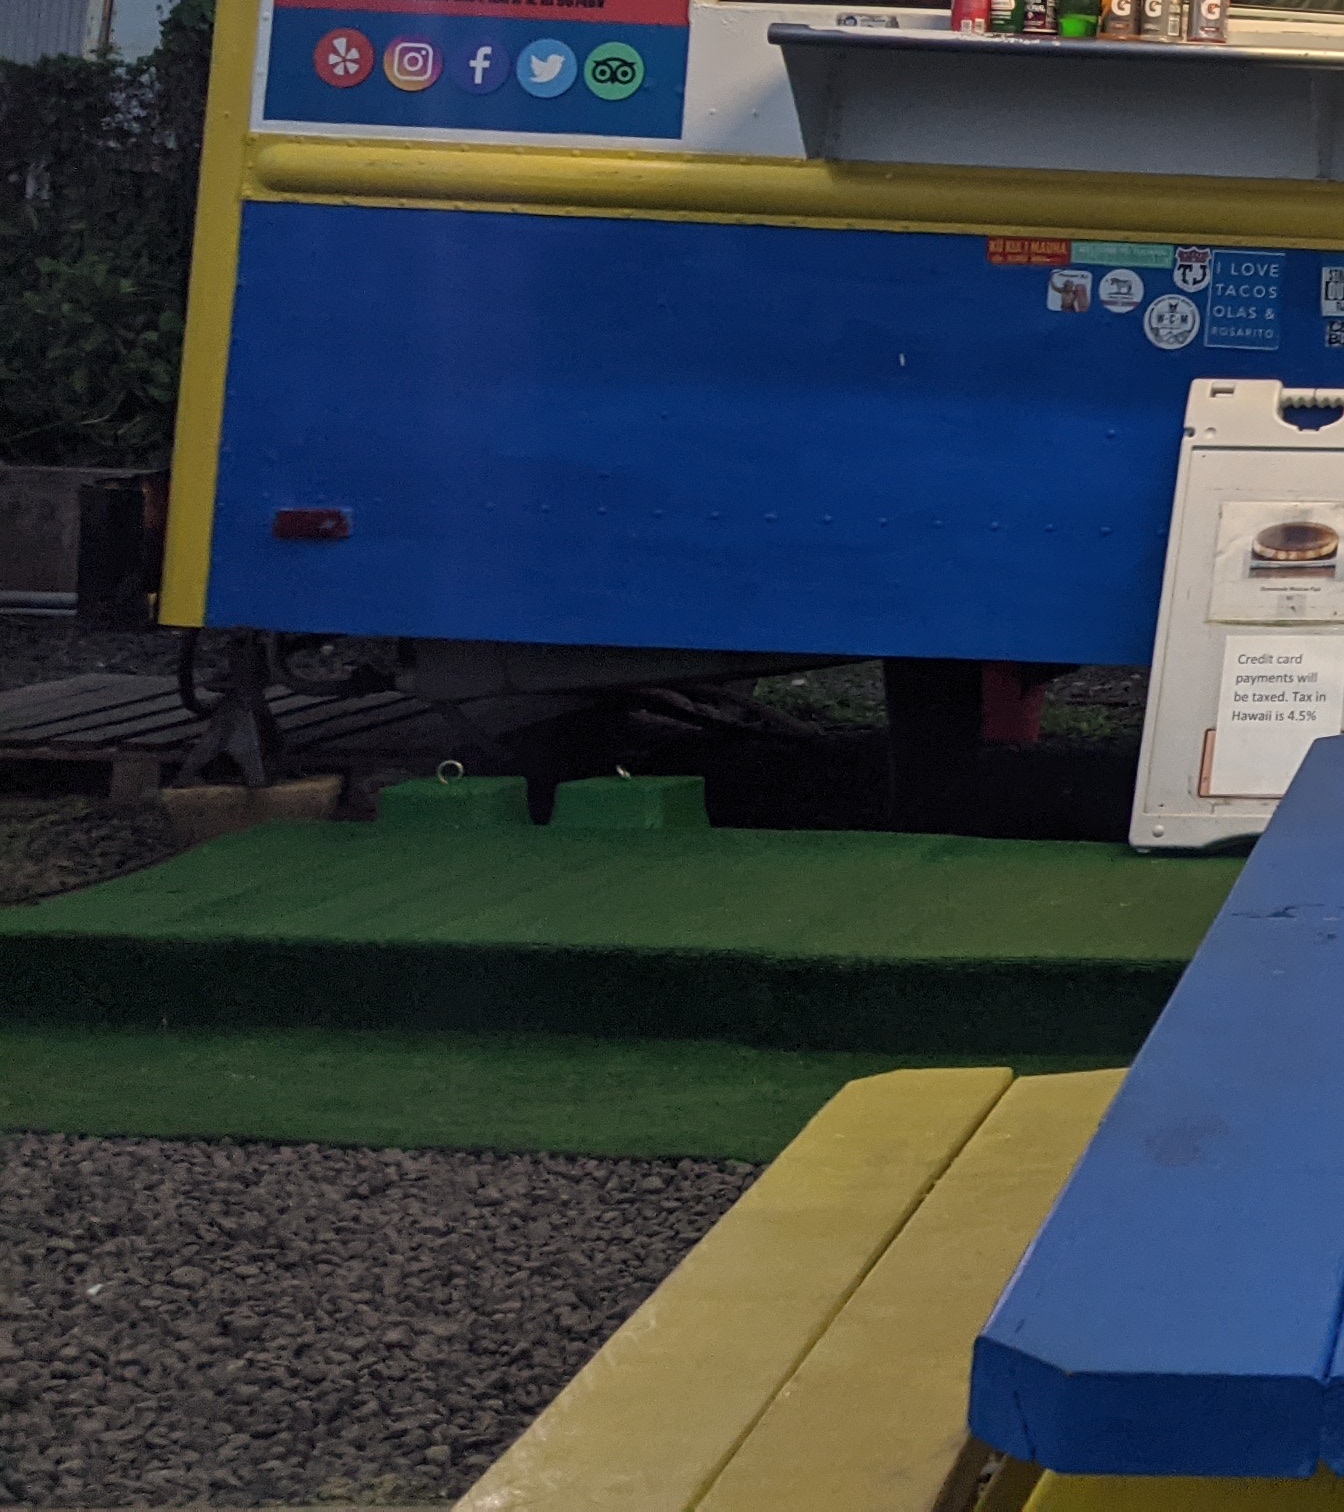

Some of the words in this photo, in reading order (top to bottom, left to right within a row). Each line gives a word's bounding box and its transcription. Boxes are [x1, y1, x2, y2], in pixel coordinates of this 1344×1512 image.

[1231, 262, 1279, 278] LOVE
[1215, 283, 1278, 299] TACOS
[1214, 305, 1258, 320] OLAS
[1264, 305, 1275, 321] &
[1238, 654, 1273, 665] Credit
[1277, 654, 1303, 664] card
[1235, 673, 1294, 685] payments
[1297, 672, 1318, 683] will
[1234, 692, 1248, 702] be
[1252, 692, 1288, 702] taxed.
[1293, 691, 1312, 702] Tax
[1316, 691, 1326, 702] in
[1232, 711, 1272, 721] Hawaii
[1275, 711, 1285, 721] is
[1288, 711, 1317, 721] 4.5%
